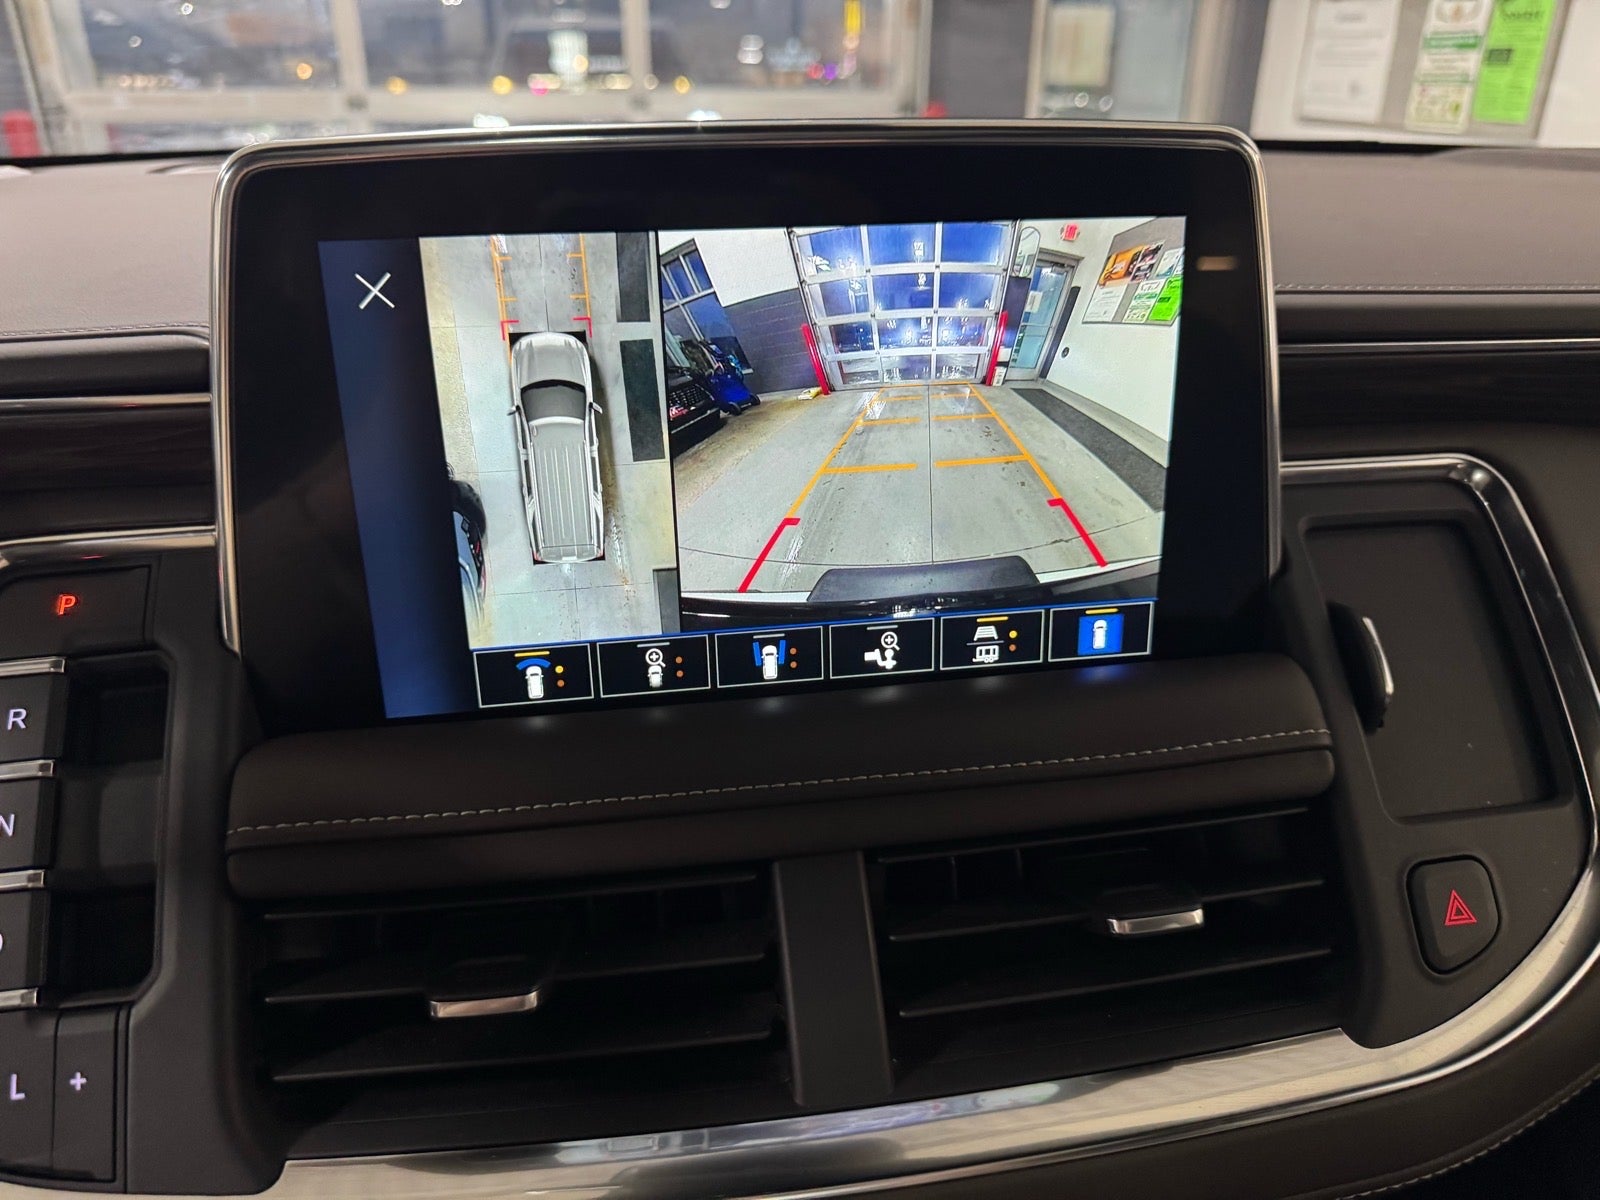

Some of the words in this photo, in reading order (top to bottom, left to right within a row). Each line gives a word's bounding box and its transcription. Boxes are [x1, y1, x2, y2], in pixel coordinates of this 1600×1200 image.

[56, 594, 77, 616] P
[7, 708, 27, 731] R
[0, 813, 15, 837] N
[9, 1073, 26, 1101] L
